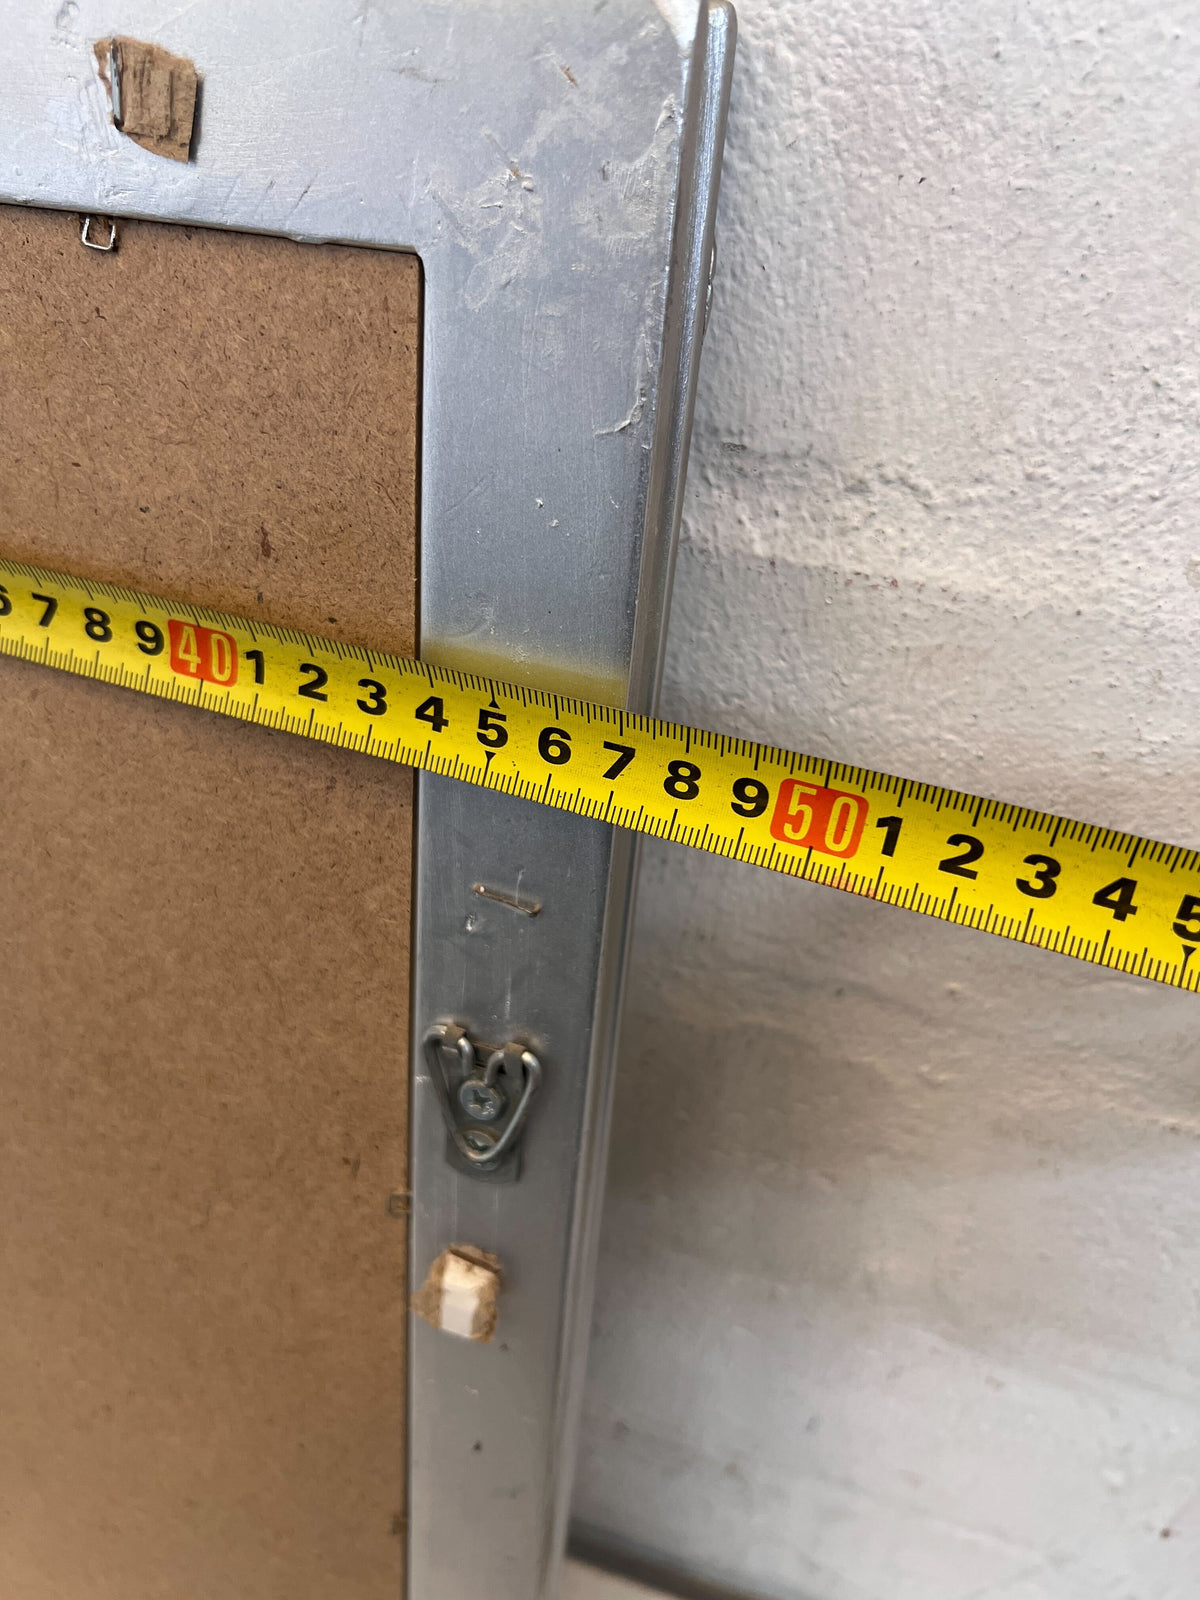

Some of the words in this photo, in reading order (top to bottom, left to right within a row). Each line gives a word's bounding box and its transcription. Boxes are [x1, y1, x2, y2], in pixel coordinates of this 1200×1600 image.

[31, 592, 58, 627] 7
[84, 607, 113, 642] 8
[135, 620, 165, 656] 9
[178, 626, 233, 682] 40
[245, 650, 265, 685] 1
[298, 663, 329, 702] 2
[356, 679, 388, 716] 3
[415, 696, 450, 733] 4
[476, 708, 508, 748] 5
[537, 726, 573, 765] 6
[602, 741, 636, 781] 7
[663, 760, 702, 800] 8
[730, 777, 770, 818] 9
[783, 783, 859, 852] 50
[875, 815, 904, 857] 1
[937, 833, 985, 880] 2
[1015, 854, 1062, 898] 3
[1092, 877, 1138, 922] 4
[1172, 894, 1200, 942] 5
